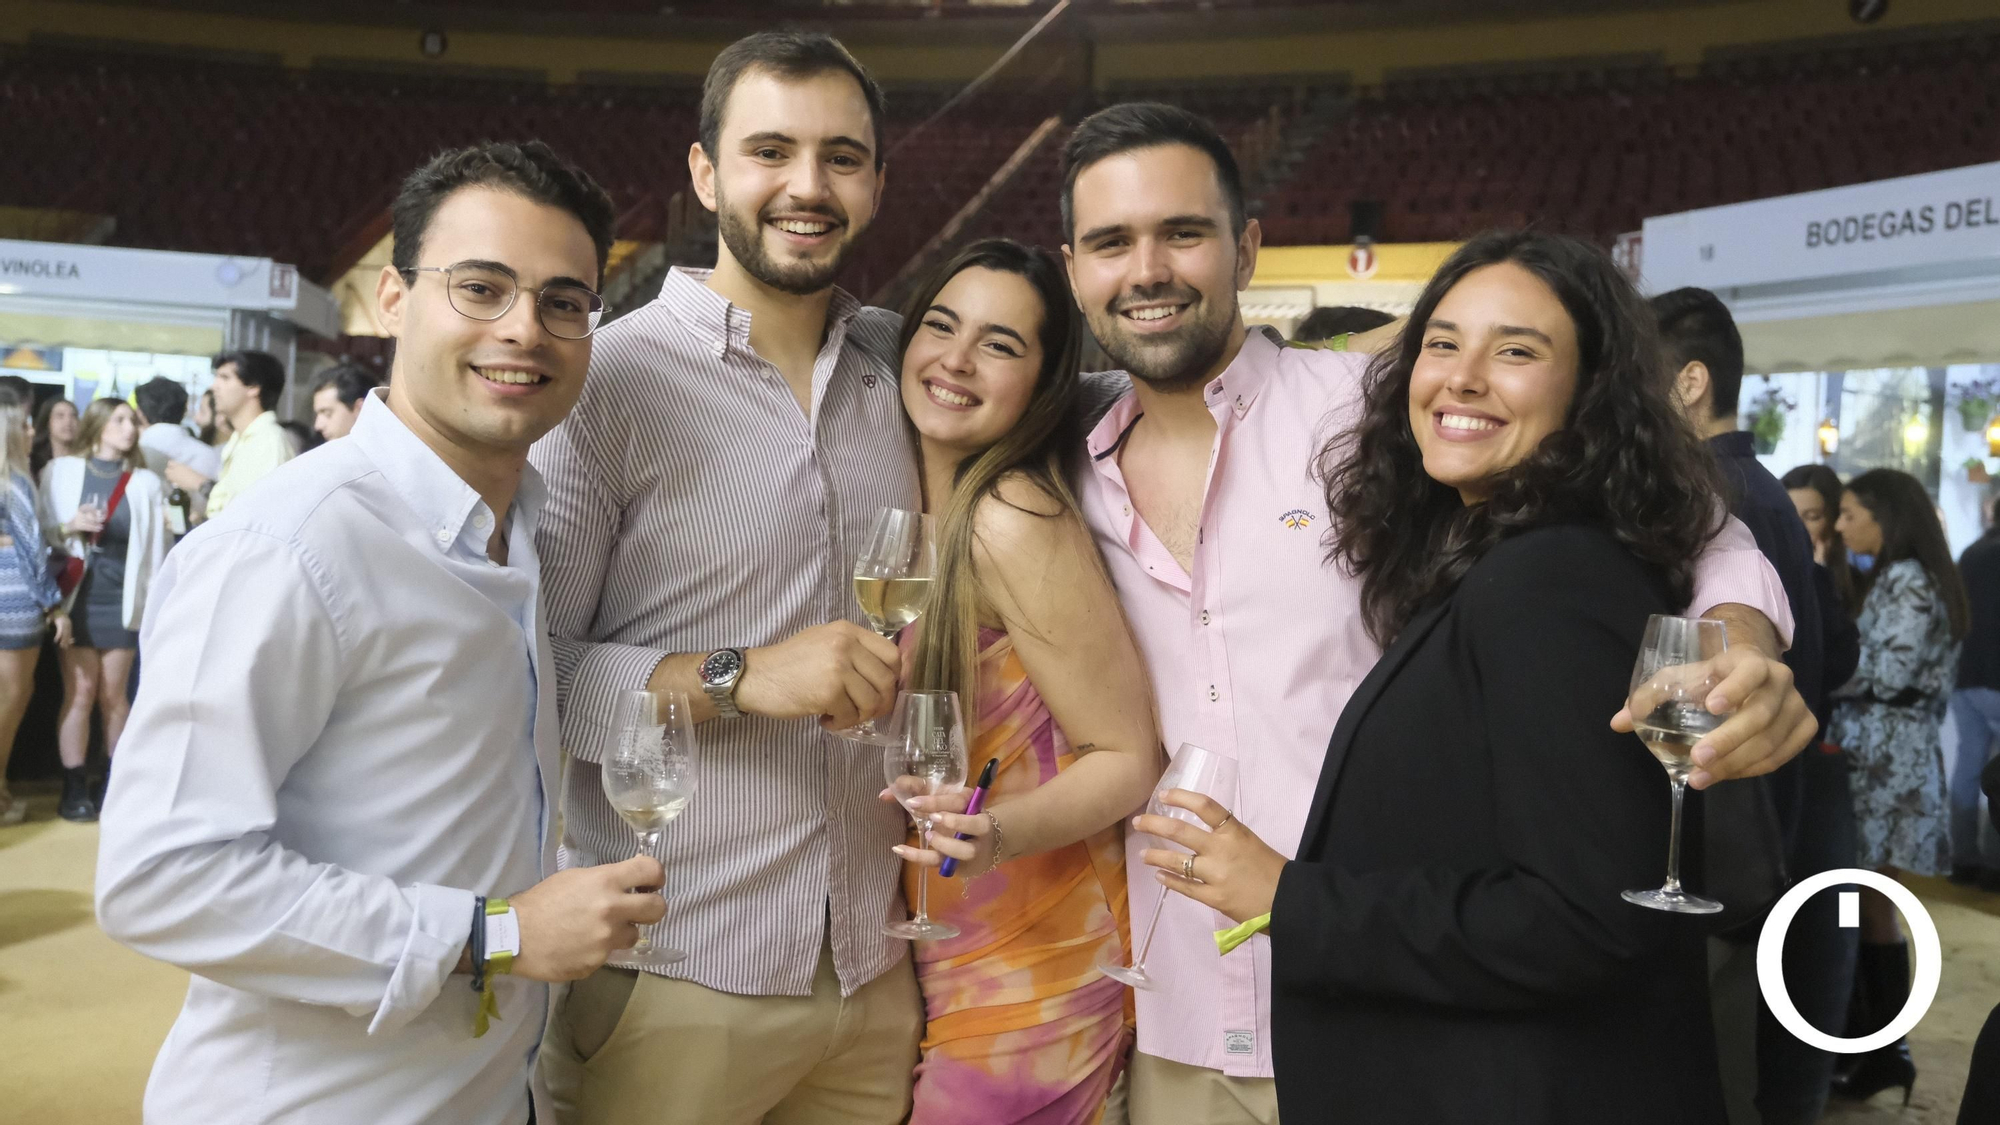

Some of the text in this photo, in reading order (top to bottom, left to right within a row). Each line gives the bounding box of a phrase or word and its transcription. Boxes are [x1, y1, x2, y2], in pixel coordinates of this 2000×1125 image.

[1805, 198, 2000, 249] BODEGAS DEL
[0, 258, 80, 279] VINOLEA
[1353, 249, 1368, 273] 1
